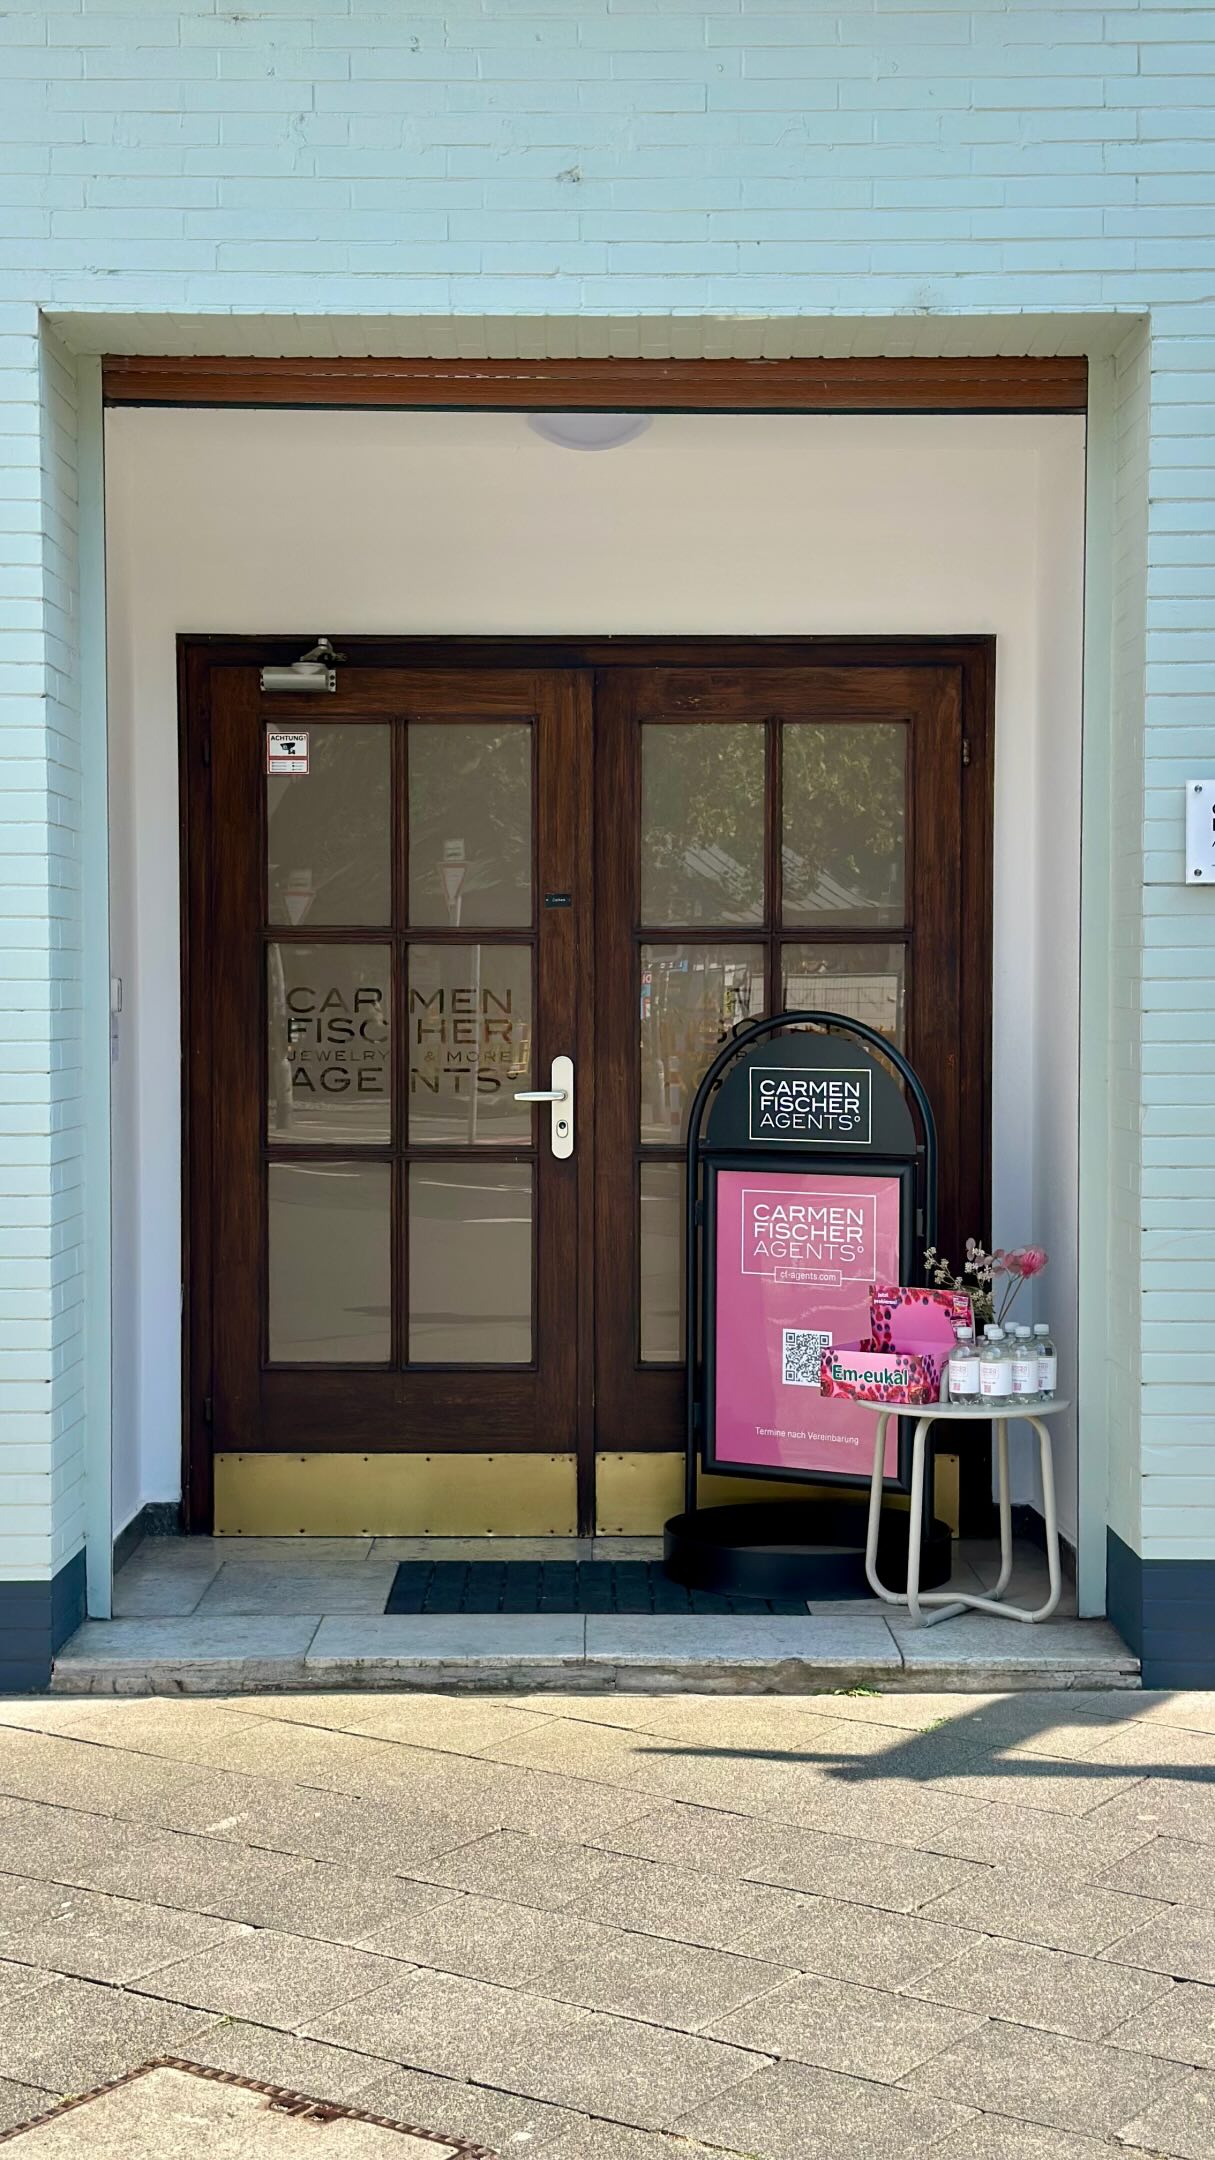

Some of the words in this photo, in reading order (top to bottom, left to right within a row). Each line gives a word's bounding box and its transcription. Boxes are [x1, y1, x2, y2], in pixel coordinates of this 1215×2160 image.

[287, 1050, 391, 1062] JEWELRY
[424, 1051, 436, 1062] &
[447, 1051, 513, 1062] MORE
[760, 1079, 860, 1097] CARMEN
[760, 1096, 860, 1113] FISCHER
[753, 1204, 864, 1225] CARMEN
[754, 1222, 863, 1243] FISCHER
[780, 1270, 837, 1281] cf-agents.com
[755, 1427, 786, 1437] Termine
[788, 1431, 806, 1439] nach
[807, 1432, 859, 1446] Vereinbarung
